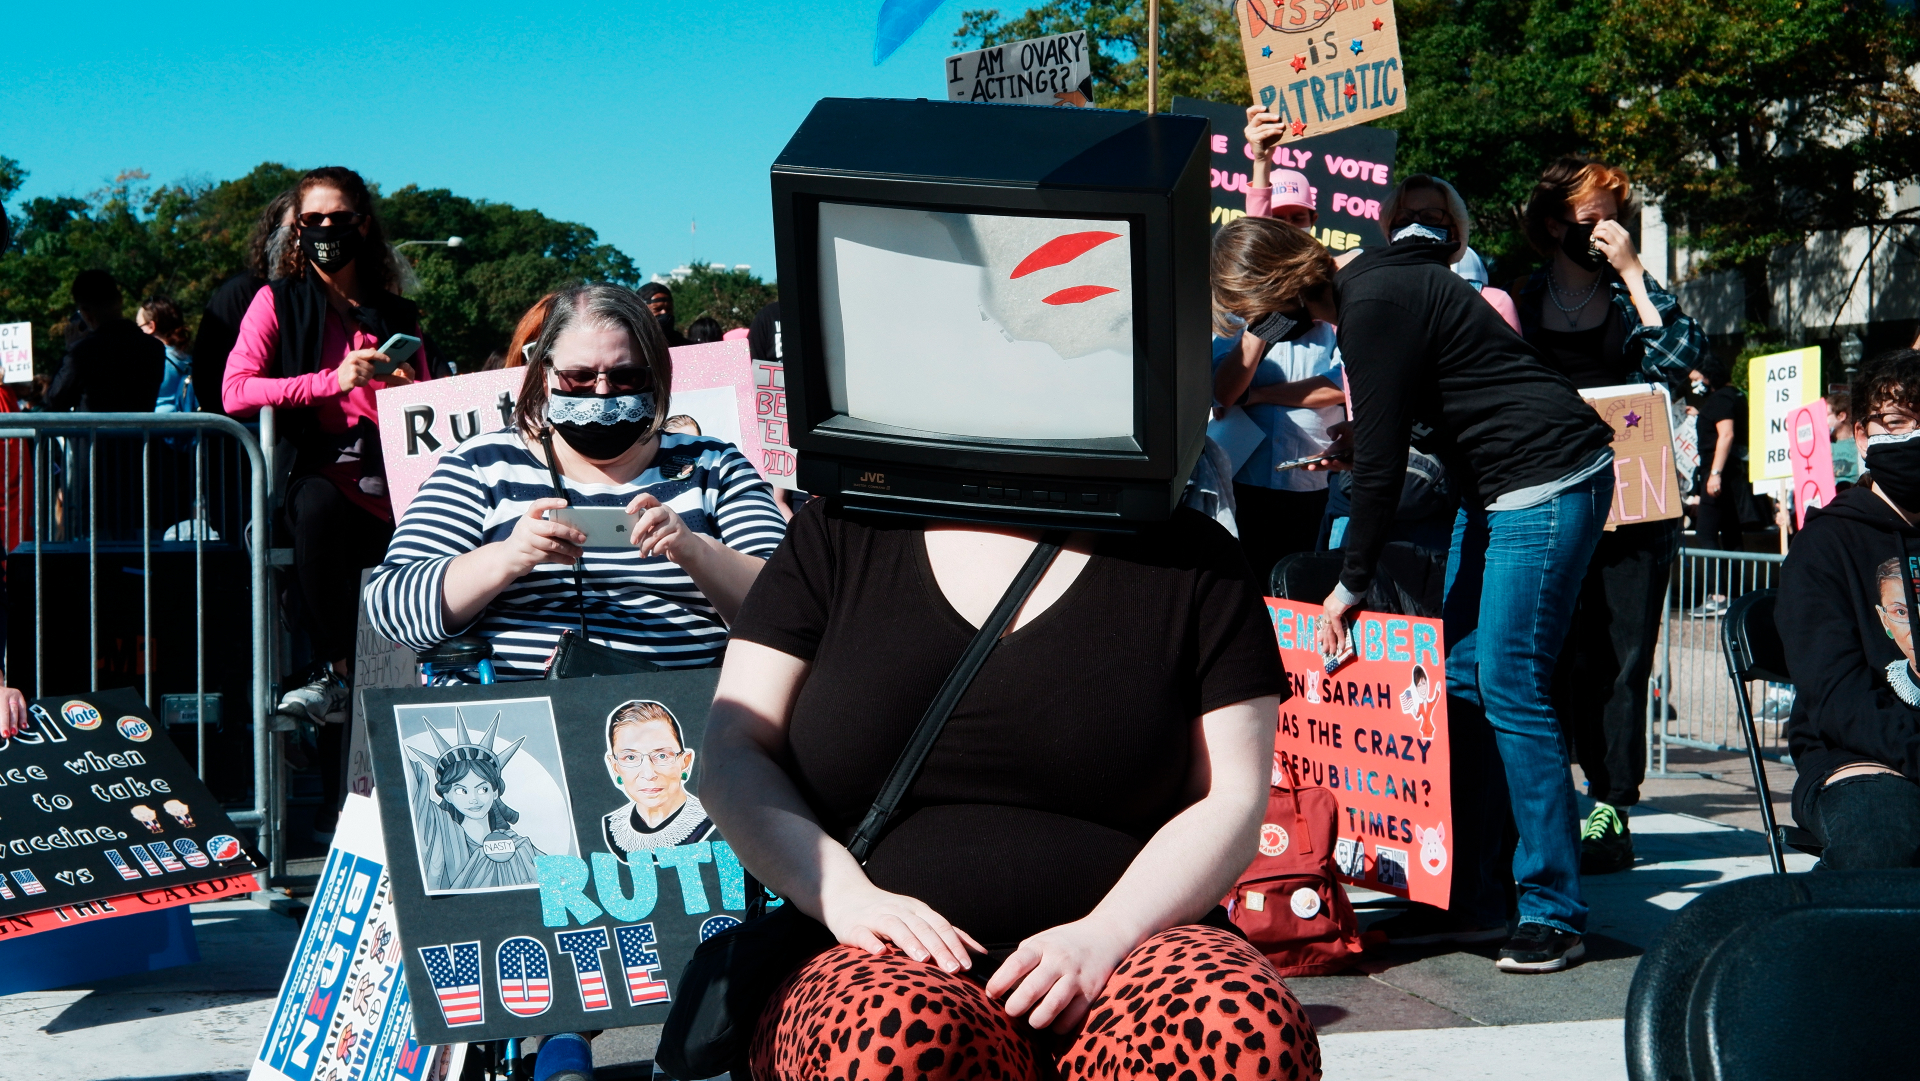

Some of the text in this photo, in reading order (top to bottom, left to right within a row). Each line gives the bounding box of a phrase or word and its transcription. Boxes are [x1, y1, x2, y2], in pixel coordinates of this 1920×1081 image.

[949, 57, 964, 84] I
[975, 48, 1004, 79] AM
[1258, 56, 1399, 124] PATRIOTIC
[1324, 154, 1389, 186] VOTE
[1332, 192, 1381, 221] FOR
[314, 241, 340, 251] COUNT
[317, 249, 341, 258] ON US
[1767, 365, 1798, 383] ACB
[1775, 388, 1790, 403] IS
[860, 471, 885, 484] JVC
[1608, 445, 1668, 522] EN
[1322, 678, 1391, 710] SARAH
[63, 708, 99, 726] Vote
[120, 722, 149, 739] Vote
[1277, 711, 1432, 765] AS THE CRAZY
[63, 750, 147, 775] when
[32, 776, 172, 813] to take
[1345, 806, 1413, 844] TIMES
[54, 867, 95, 886] vs
[104, 838, 210, 881] LIES
[484, 841, 512, 852] NASTY
[315, 881, 333, 923] VOTE
[366, 866, 391, 931] NITY
[278, 865, 348, 1056] THIS IS THE WAY
[283, 929, 316, 1013] NOVEMBER
[300, 940, 329, 1017] PRESIDENT
[341, 938, 369, 1004] OVER
[417, 921, 672, 1029] VOTE
[373, 980, 405, 1069] NOVEMBER
[387, 1001, 408, 1047] THE
